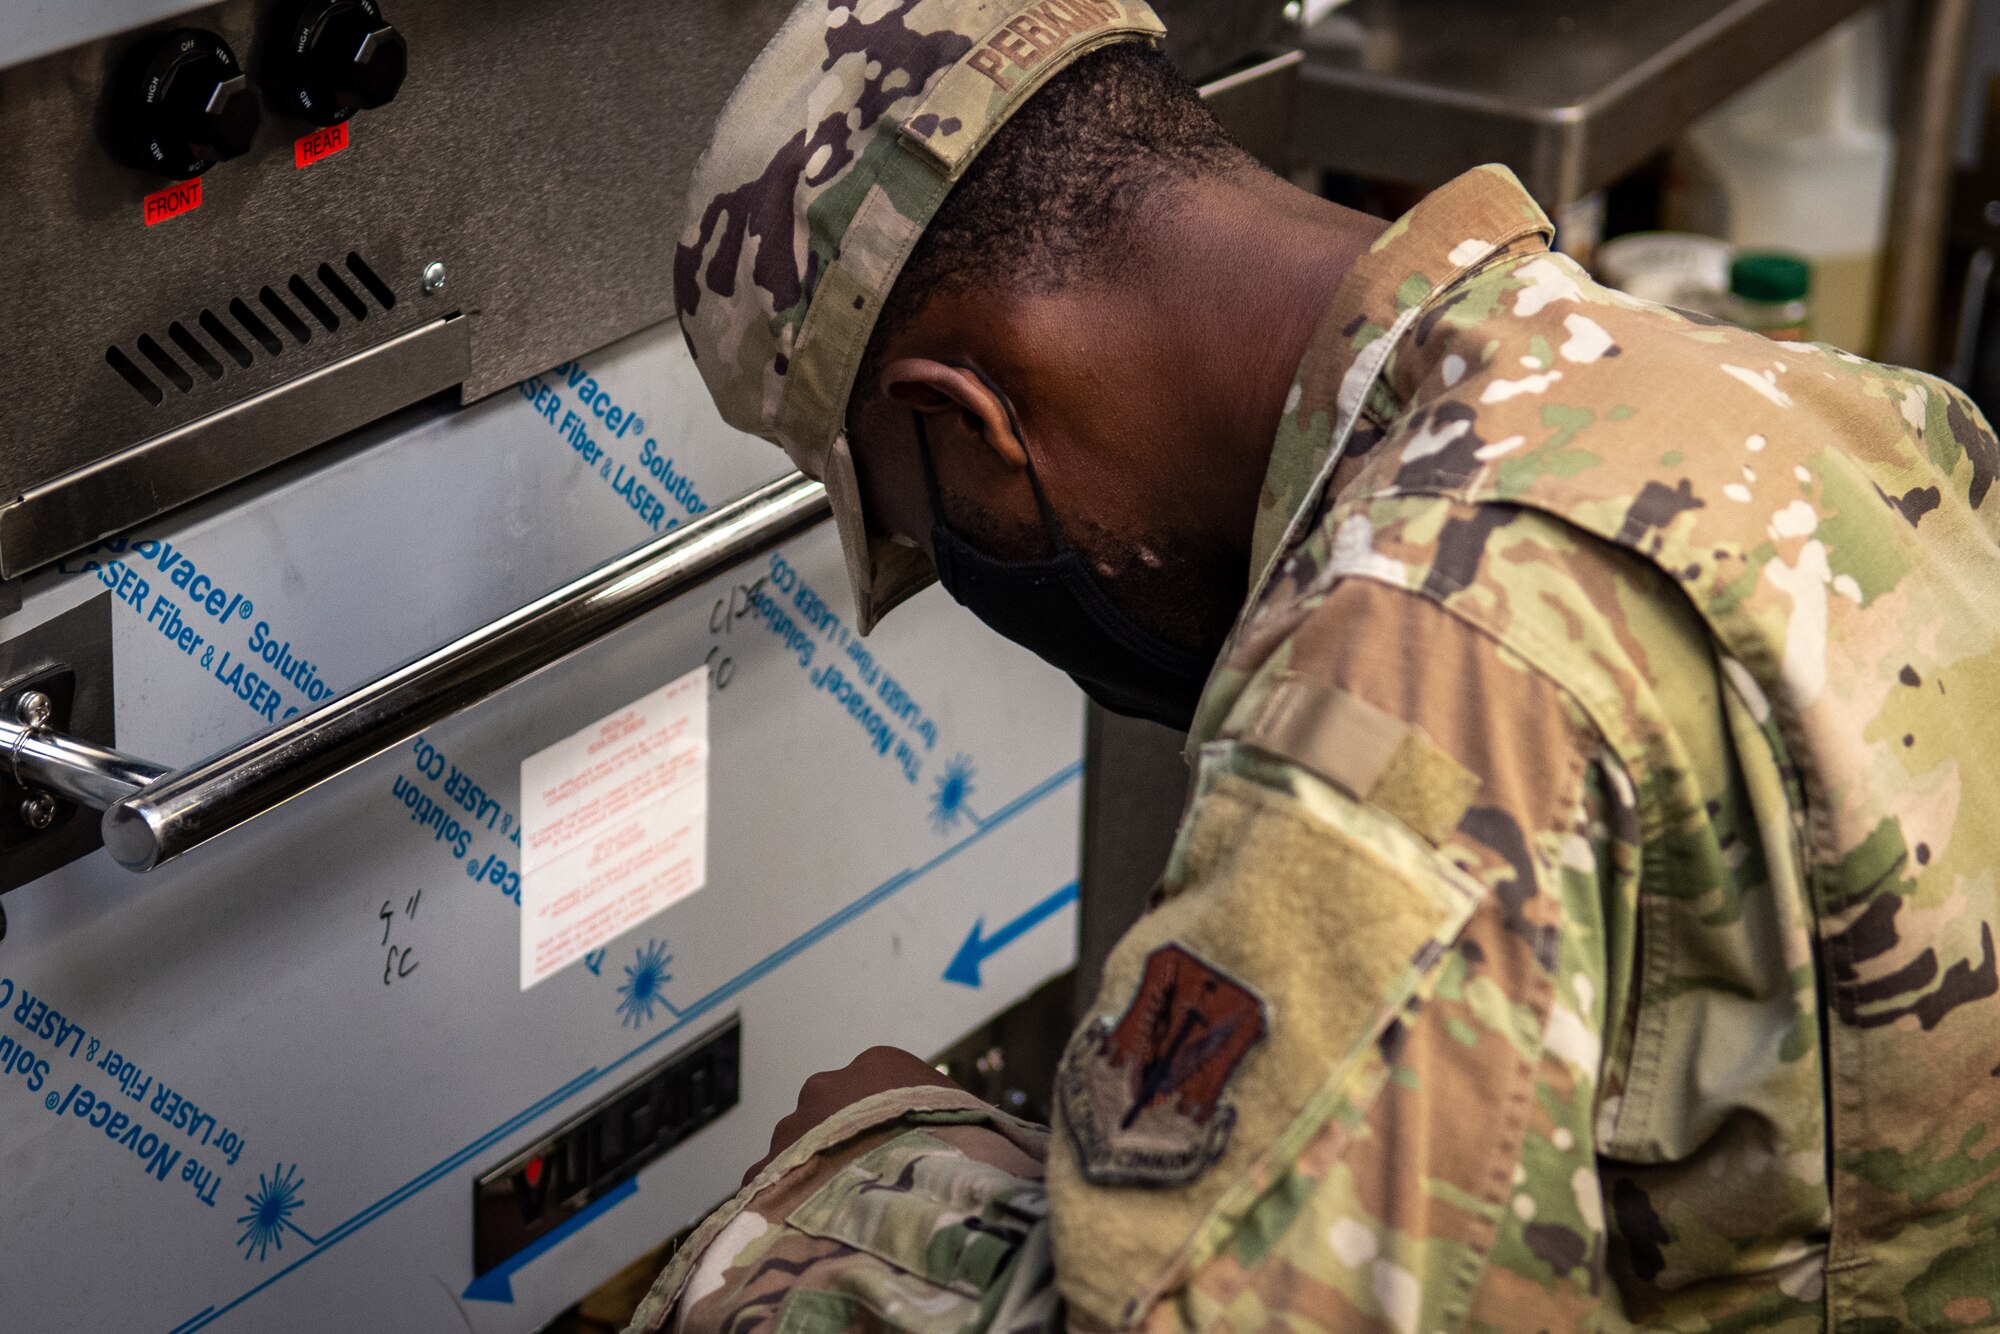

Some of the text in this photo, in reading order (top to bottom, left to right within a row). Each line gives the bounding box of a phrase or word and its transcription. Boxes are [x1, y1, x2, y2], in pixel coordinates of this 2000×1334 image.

[180, 39, 195, 51] OFF
[214, 46, 230, 65] VERY
[297, 28, 310, 53] HIGH
[146, 76, 160, 103] HIGH
[150, 142, 165, 161] MED
[303, 128, 342, 160] REAR
[146, 182, 200, 221] FRONT
[518, 376, 666, 532] SER Fiber & LASER
[147, 595, 204, 656] Fiber
[200, 645, 215, 671] &
[214, 652, 282, 724] LASER
[391, 774, 473, 860] Solution
[443, 766, 502, 830] LASER
[12, 989, 87, 1059] LASER
[0, 1034, 51, 1093] Solu
[84, 1036, 101, 1062] &
[96, 1048, 153, 1103] Fiber
[149, 1082, 218, 1147] LASER
[212, 1127, 246, 1166] for
[180, 1157, 223, 1209] The
